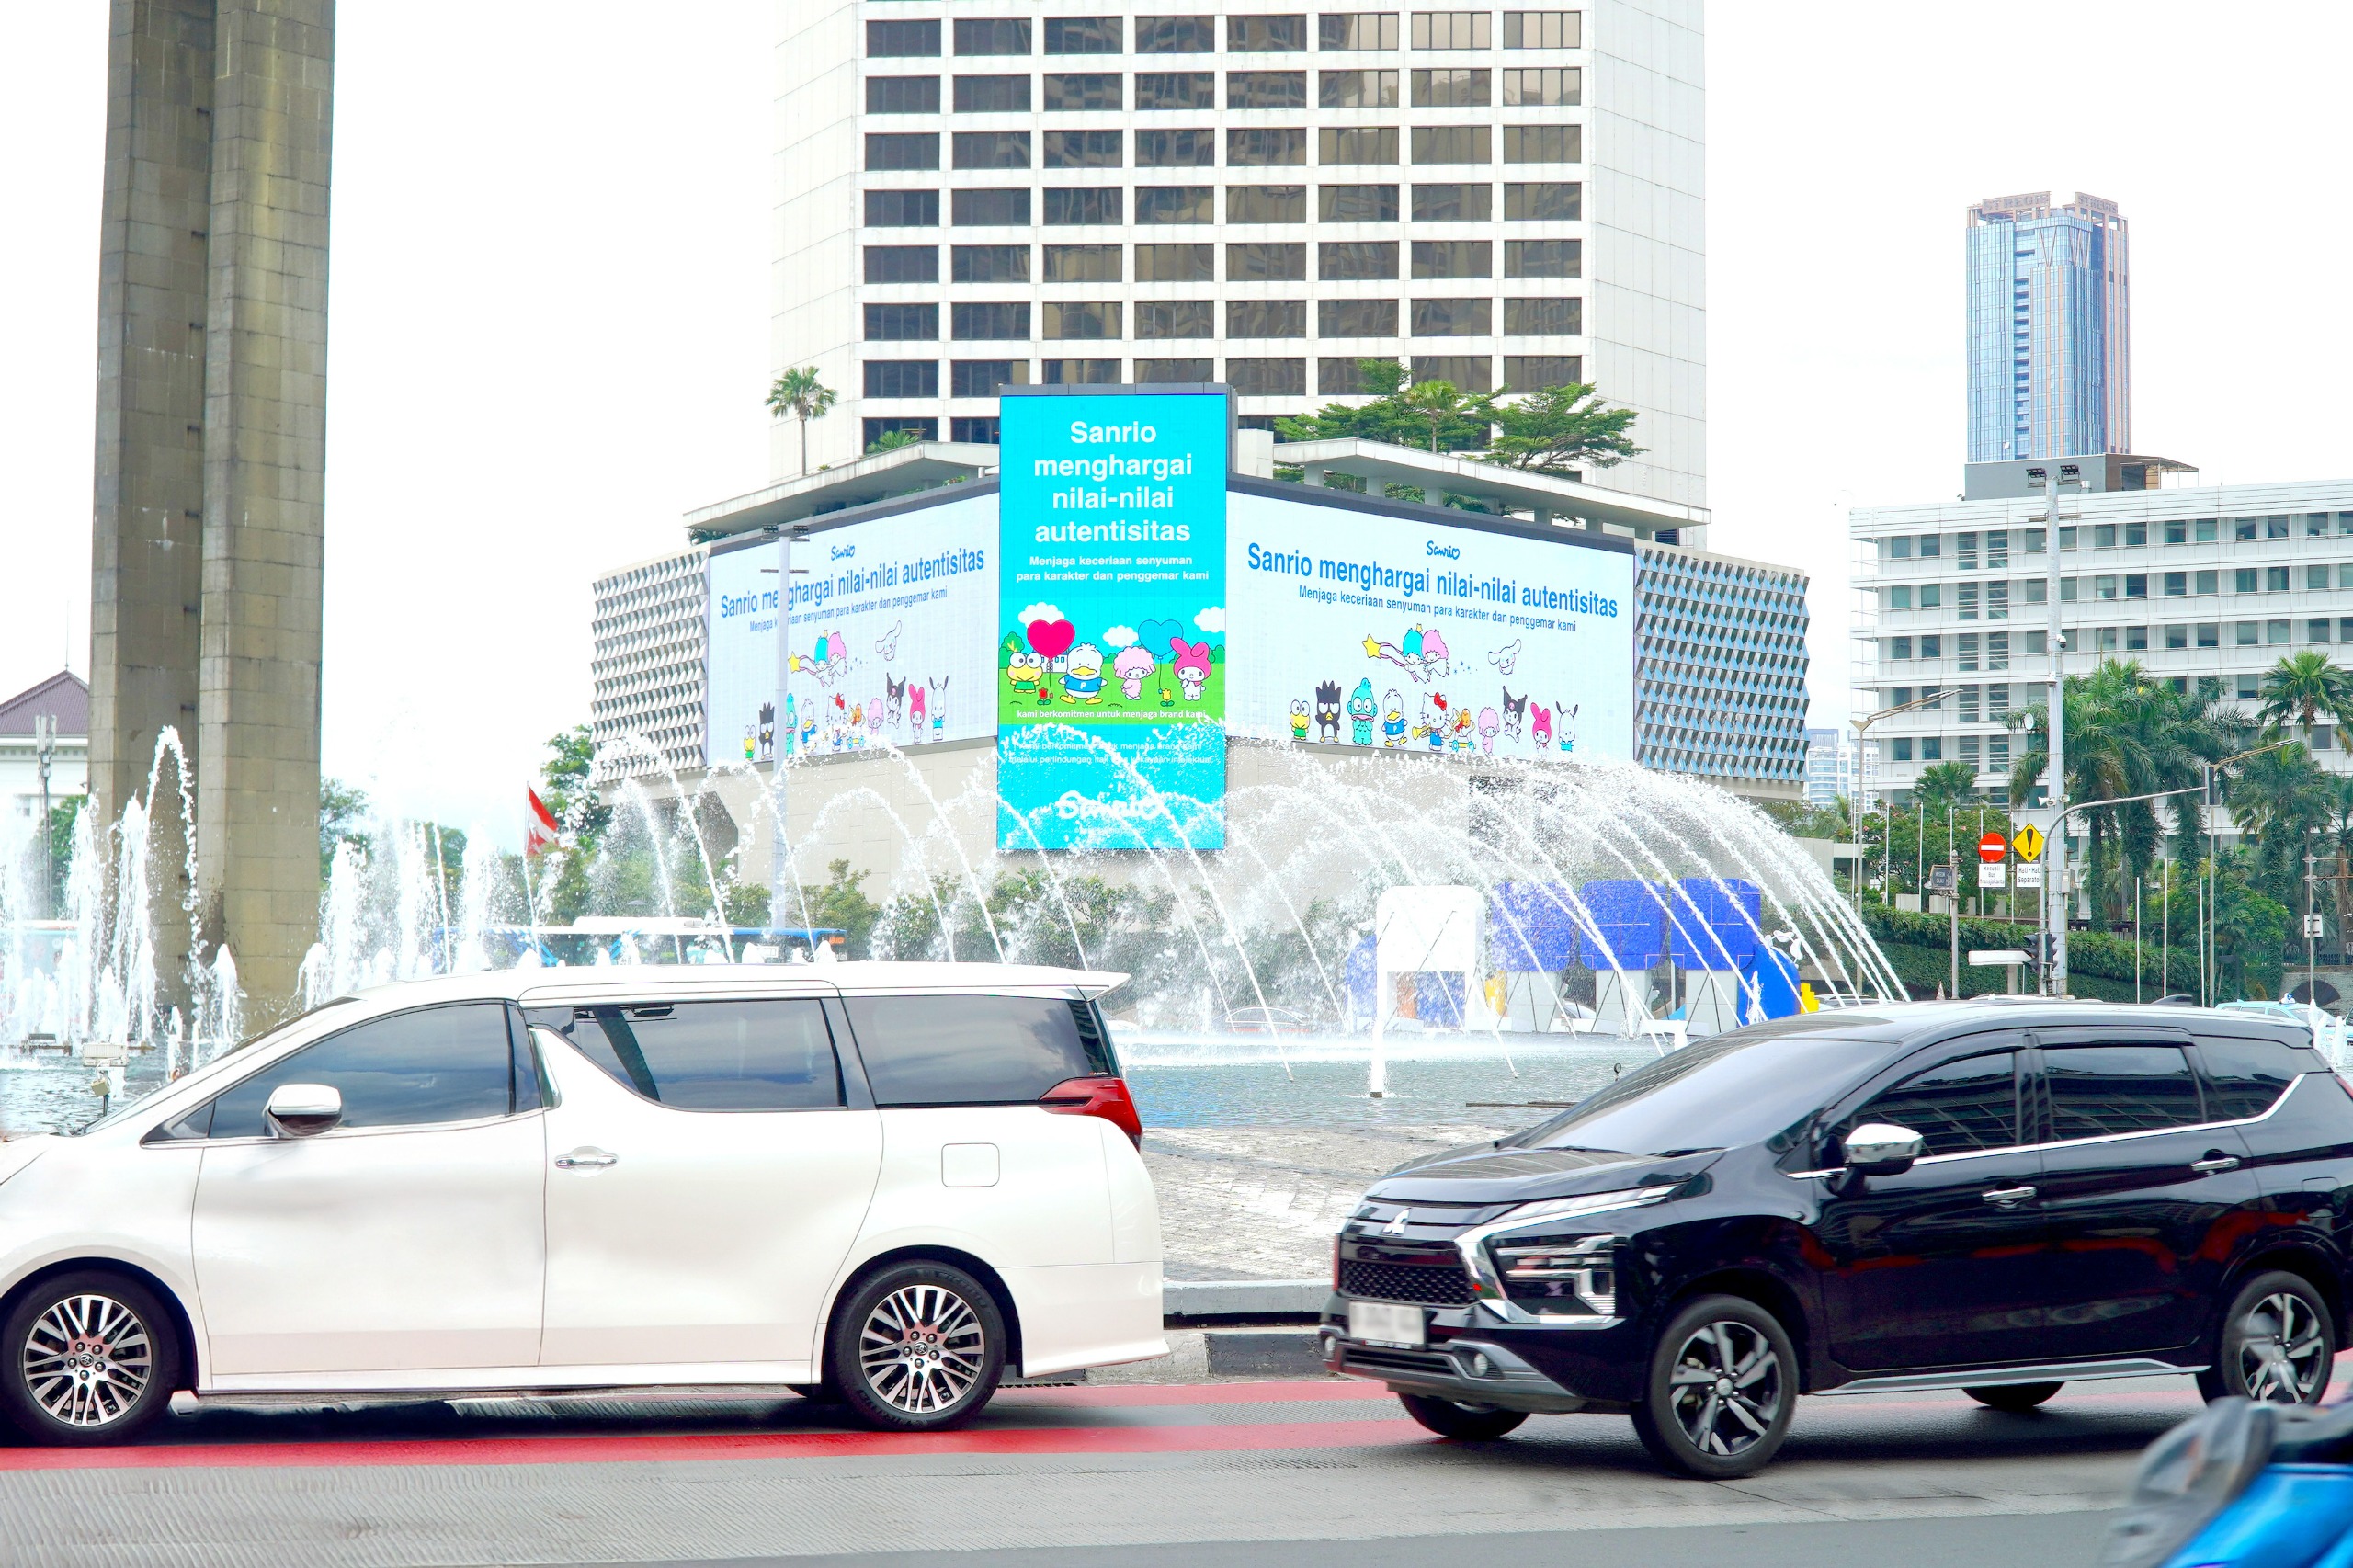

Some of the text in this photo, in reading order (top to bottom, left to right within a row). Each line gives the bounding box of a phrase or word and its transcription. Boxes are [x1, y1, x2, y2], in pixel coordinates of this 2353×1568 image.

[1070, 420, 1157, 444] Sanrio
[1034, 453, 1192, 482] menghargai
[1052, 486, 1174, 509] nilai-nilai
[1035, 519, 1191, 543] autentisitas
[831, 544, 856, 562] Sanrio
[1029, 555, 1193, 568] Menjaga keceriaan senyuman
[1427, 540, 1461, 560] Sanrio
[721, 547, 984, 619] Sanrio meghargai nilai-nilai autentisitas
[1016, 570, 1210, 583] para karakter dan penggemar kami
[1248, 542, 1618, 619] Sanrio menghargai nilai-nilai autentisitas
[749, 585, 948, 632] Menjaga kriaan senyuman para karakter dan penggemar kami
[1299, 585, 1576, 631] Menjaga keceriaan senyuman para karakter dan penggemar kami
[1039, 710, 1095, 718] berkomitmen
[1122, 710, 1158, 720] menjaga
[1159, 710, 1184, 718] brand
